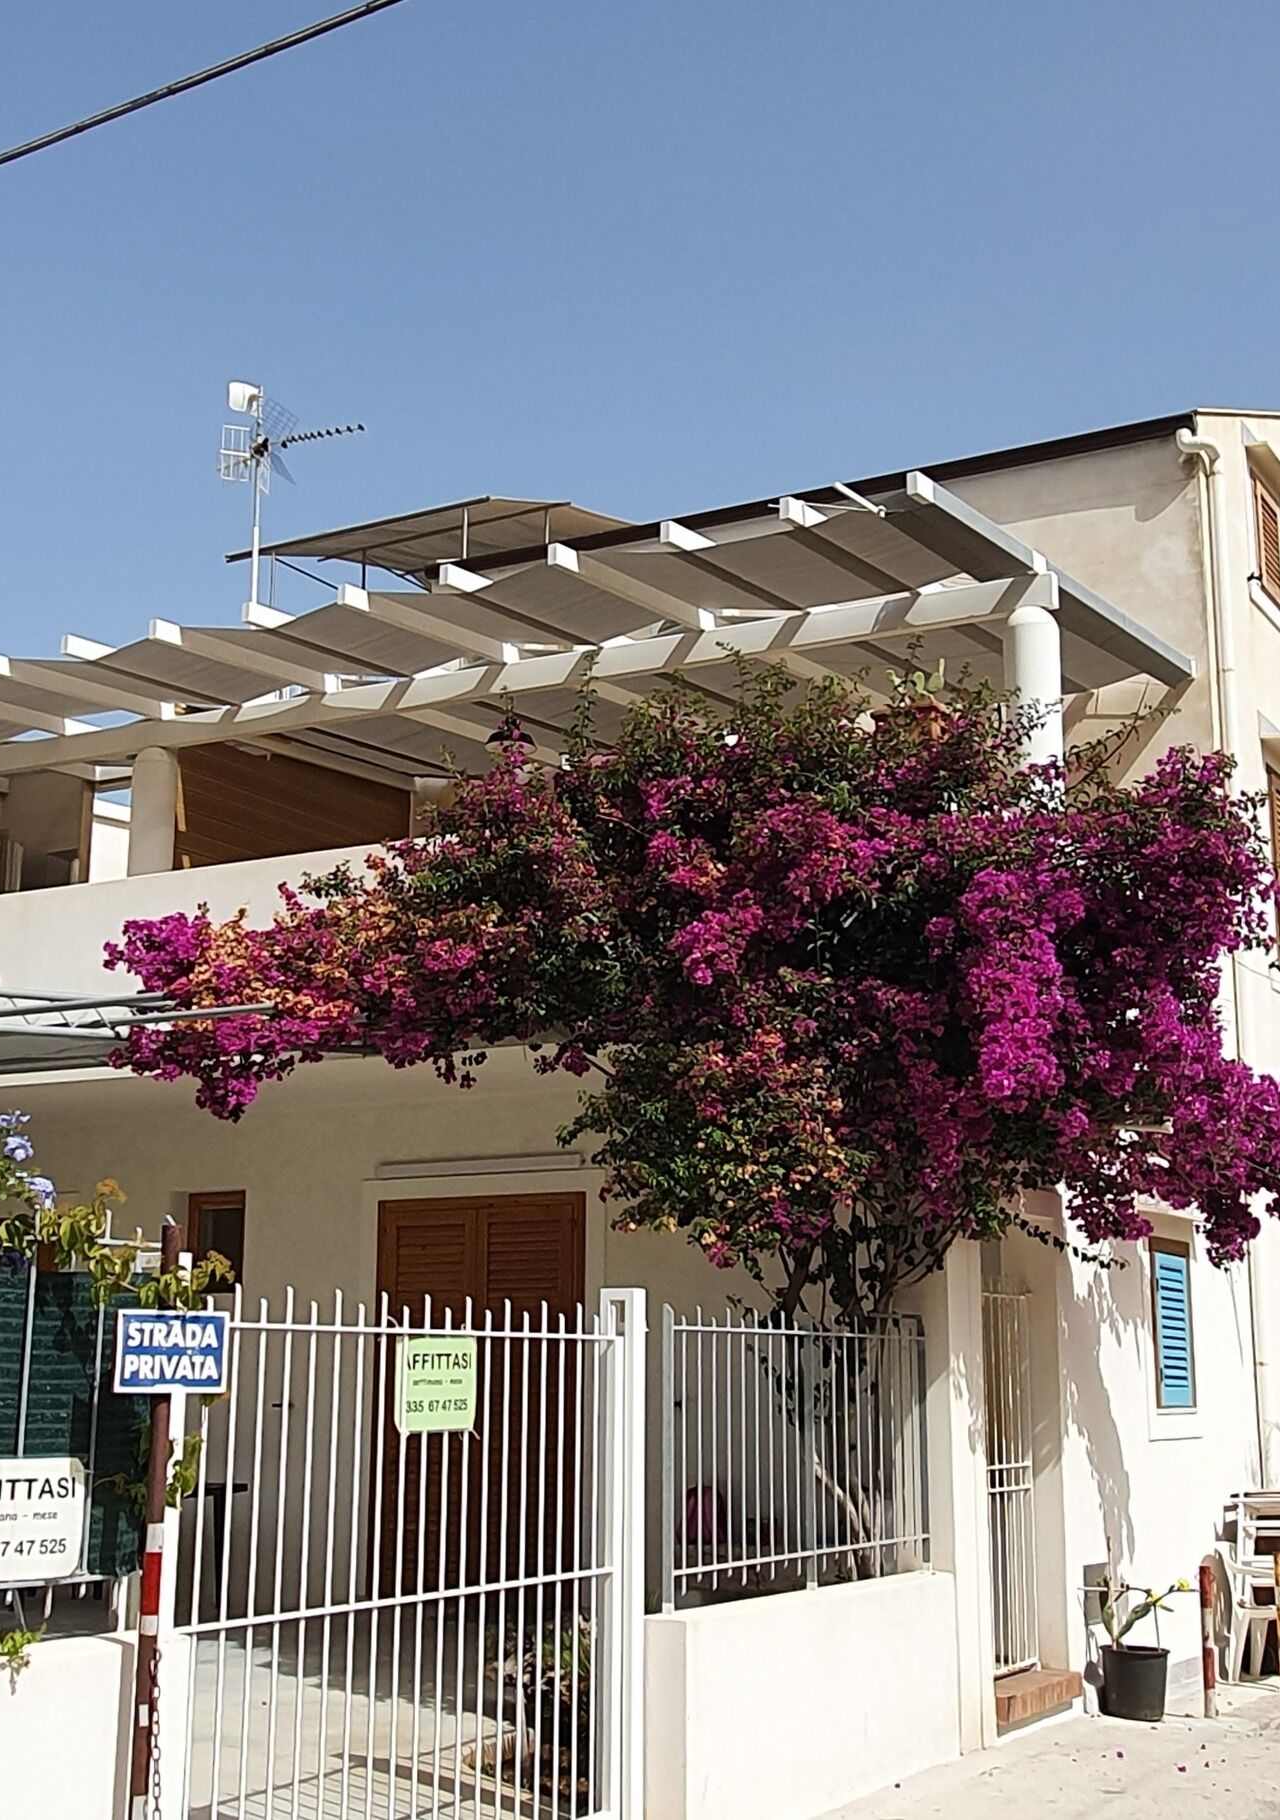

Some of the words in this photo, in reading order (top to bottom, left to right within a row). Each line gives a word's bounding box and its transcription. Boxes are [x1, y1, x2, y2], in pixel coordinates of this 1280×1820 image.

[127, 1321, 219, 1349] STRADA
[123, 1354, 220, 1381] PRIVATA
[32, 1511, 59, 1521] mese
[13, 1539, 36, 1556] 47
[38, 1538, 68, 1555] 525
